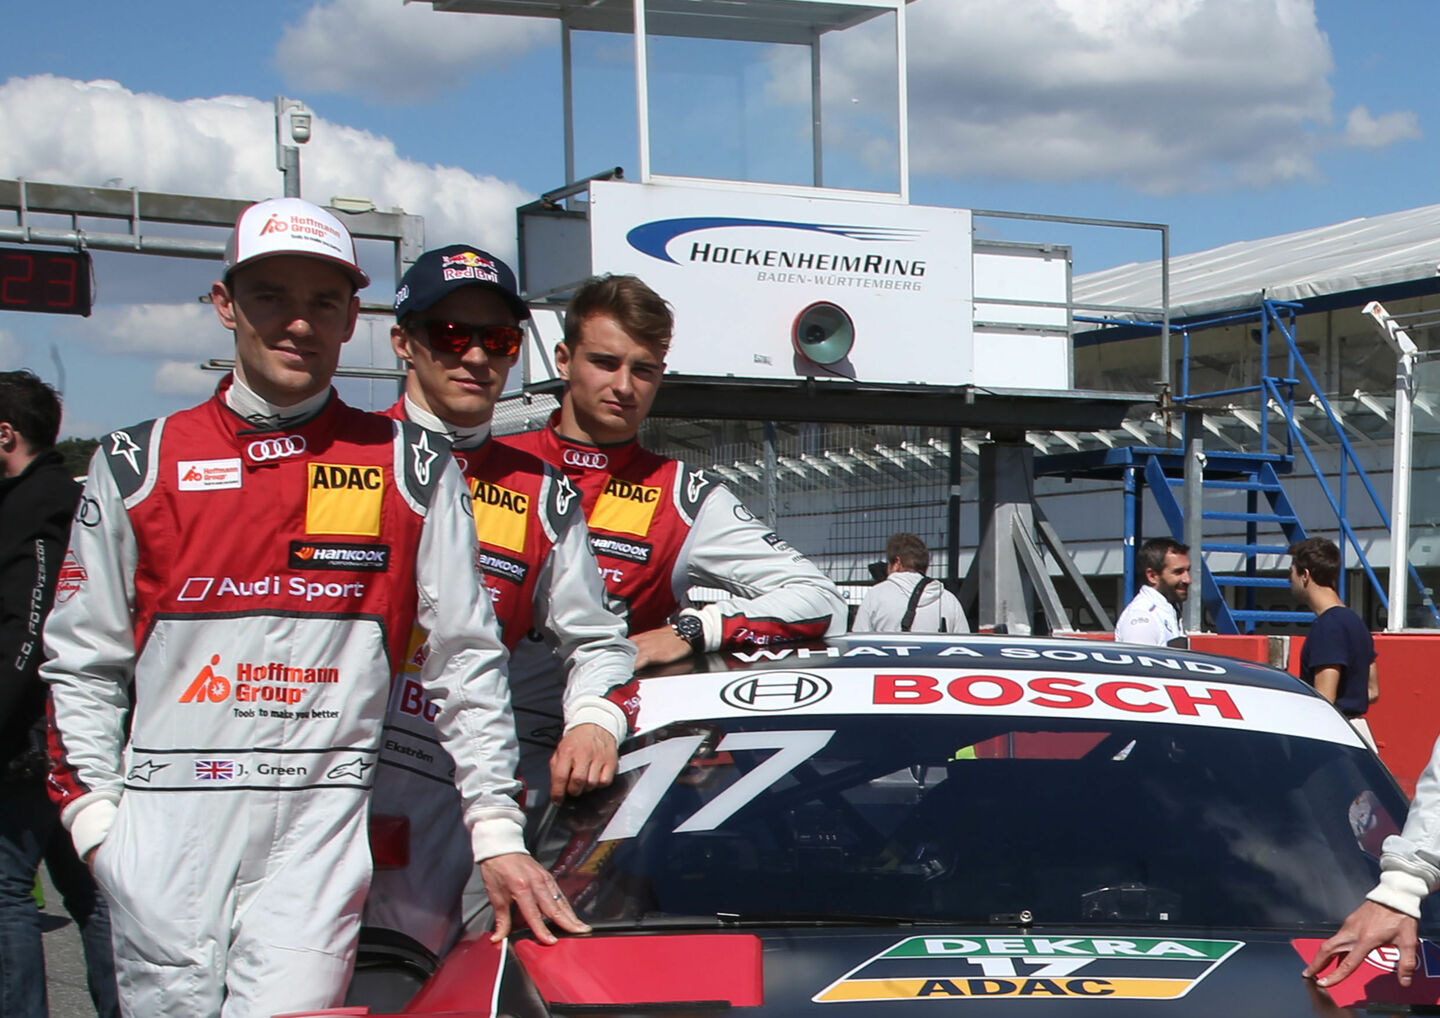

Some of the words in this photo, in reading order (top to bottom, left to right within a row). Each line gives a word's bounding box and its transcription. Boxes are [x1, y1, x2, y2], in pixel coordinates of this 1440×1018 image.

[290, 216, 341, 239] Hoffmann
[291, 224, 324, 238] Group
[443, 267, 474, 281] Red
[476, 266, 498, 283] Bull
[757, 271, 922, 291] BADEN-WÜRTTEMBERG
[312, 466, 381, 490] ADAC
[474, 481, 526, 514] ADAC
[604, 480, 658, 503] ADAC
[217, 576, 280, 597] Audi
[288, 577, 364, 601] Sport
[731, 646, 922, 663] WHAT
[937, 646, 983, 657] A
[999, 647, 1228, 675] SOUND
[237, 662, 339, 684] Hoffmann
[235, 683, 303, 705] Group
[872, 673, 1245, 721] BOSCH
[233, 708, 256, 718] Tools
[259, 708, 269, 717] to
[271, 708, 294, 719] make
[296, 710, 310, 721] you
[311, 708, 339, 718] better
[385, 739, 434, 764] Ekström
[237, 765, 249, 776] J.
[257, 764, 307, 776] Green
[597, 730, 837, 842] 17
[923, 938, 1209, 957] DEKRA
[966, 957, 1097, 977] 17
[917, 979, 1116, 997] ADAC
